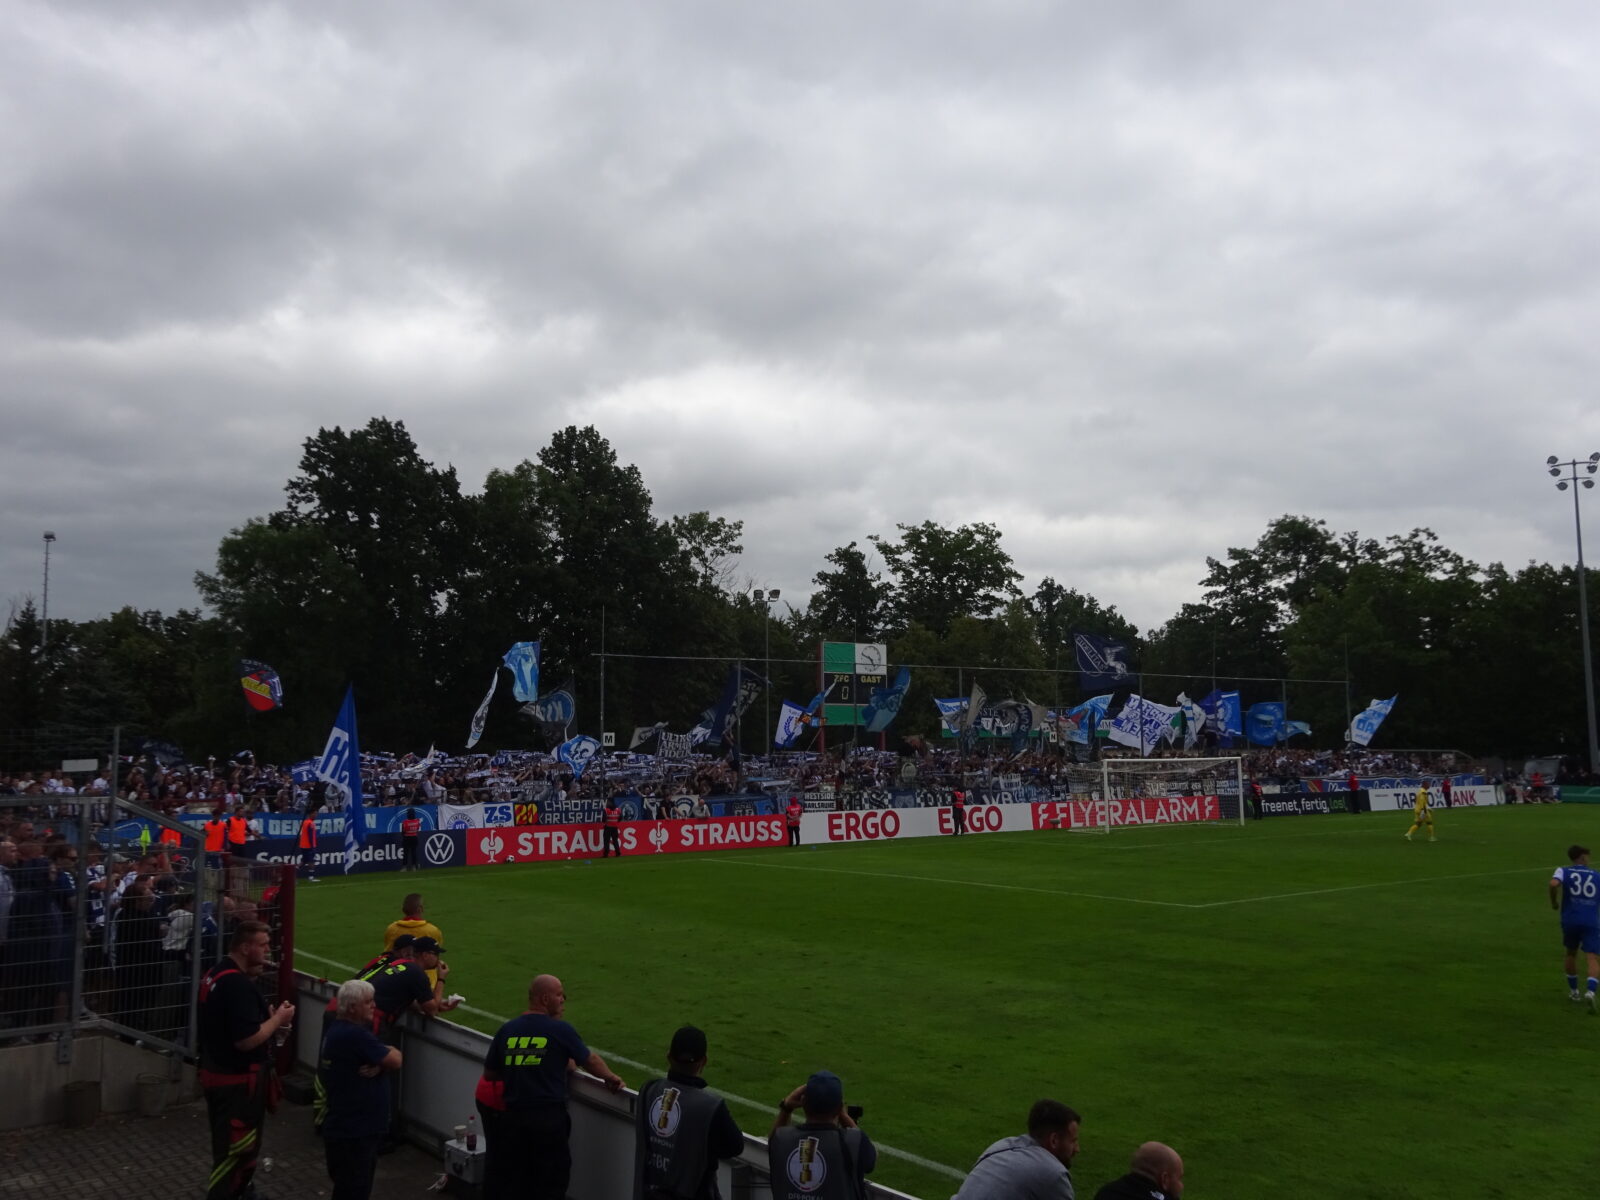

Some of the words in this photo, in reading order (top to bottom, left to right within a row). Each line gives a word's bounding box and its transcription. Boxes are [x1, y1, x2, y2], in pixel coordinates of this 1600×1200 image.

[860, 675, 881, 685] GAST
[604, 735, 613, 743] M
[1394, 792, 1433, 807] TARO
[1453, 790, 1477, 805] ANK
[539, 812, 603, 825] KARLSRUH
[1056, 797, 1199, 828] FLYERALARM
[680, 820, 783, 846] STRAUSS
[828, 810, 900, 841] ERGO
[517, 827, 638, 856] STRAUS
[256, 843, 405, 866] Sonermodelle
[1569, 872, 1596, 898] 36
